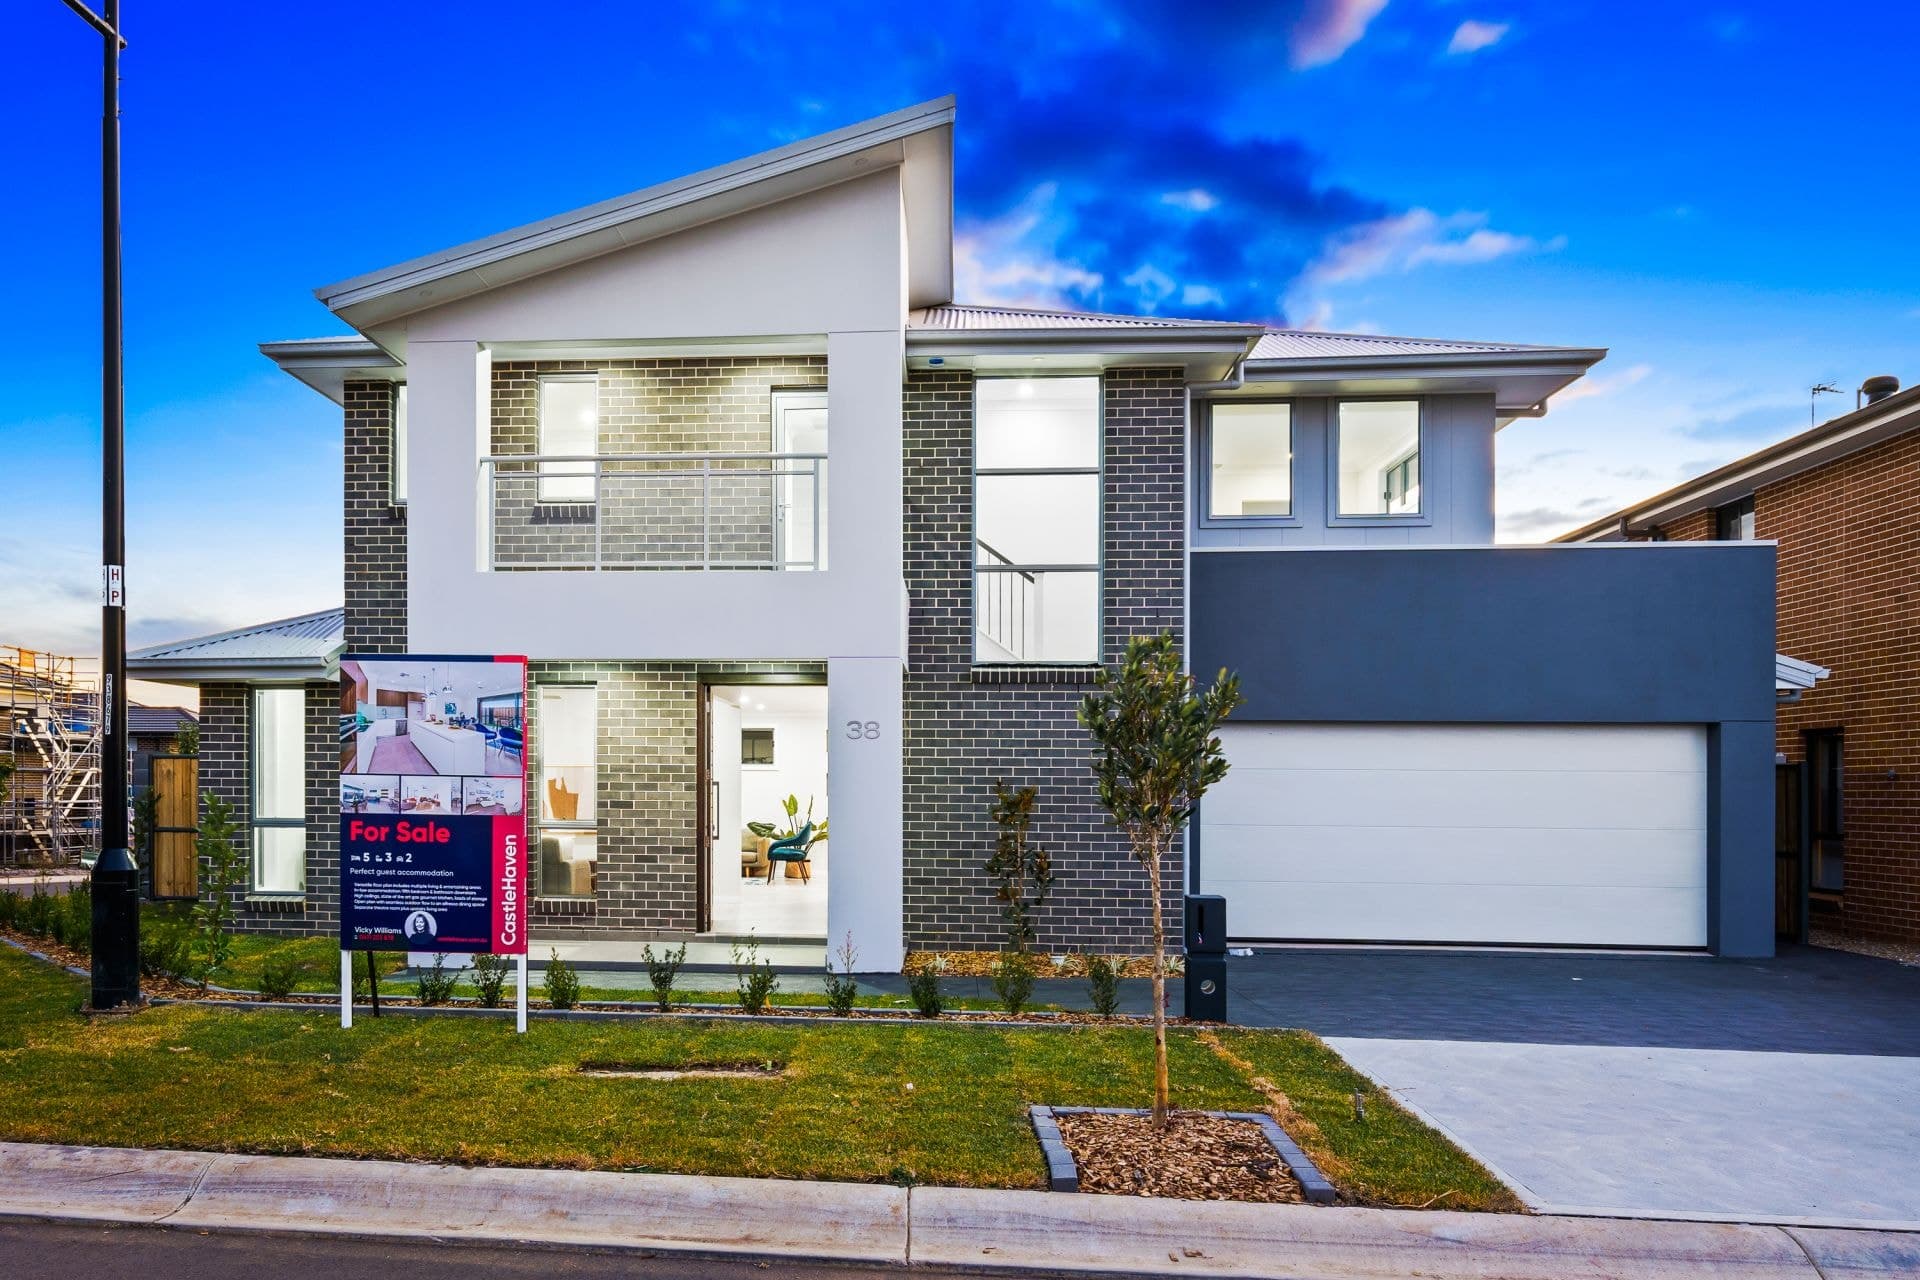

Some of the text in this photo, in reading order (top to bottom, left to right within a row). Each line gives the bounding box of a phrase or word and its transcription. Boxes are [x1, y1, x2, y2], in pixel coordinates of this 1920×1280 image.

[111, 568, 120, 581] H
[111, 590, 120, 603] P
[846, 720, 881, 740] 38
[350, 820, 451, 843] For Sale
[363, 853, 413, 862] 5 3 2
[350, 867, 454, 877] Perfect guest accommodation
[501, 834, 518, 946] CastleHaven
[354, 926, 402, 935] Vicky Williams
